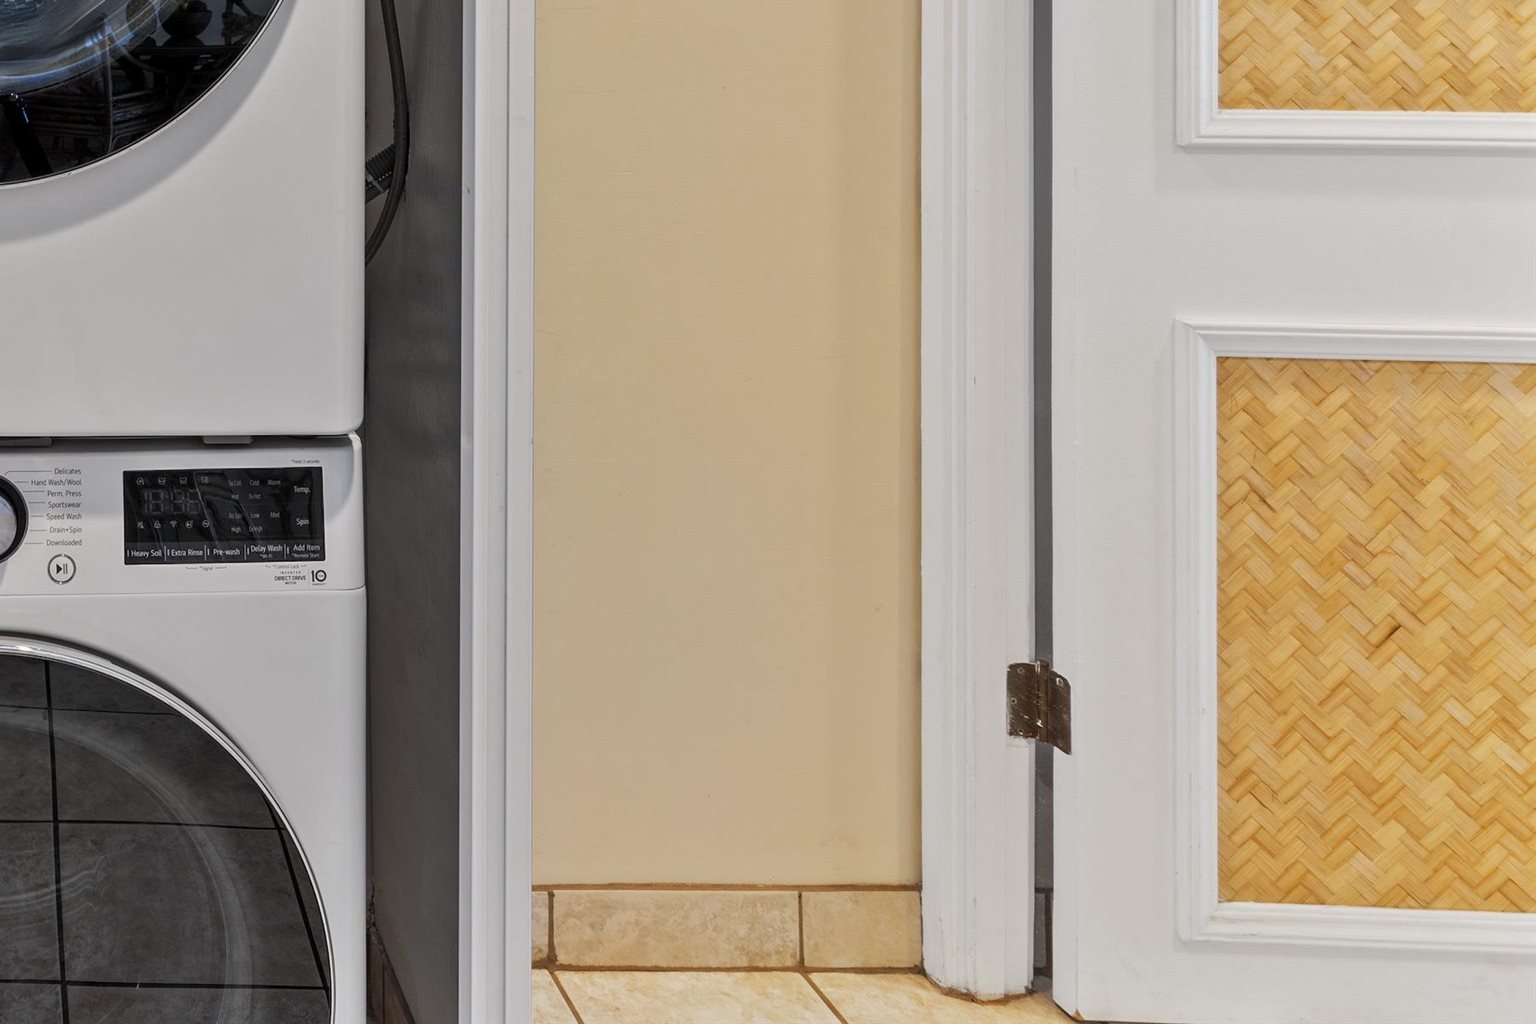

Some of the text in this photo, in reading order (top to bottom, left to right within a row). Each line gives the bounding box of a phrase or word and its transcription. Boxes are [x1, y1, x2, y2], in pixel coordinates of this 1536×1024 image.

[294, 486, 311, 494] Temp.
[48, 501, 82, 509] Sportswear
[296, 518, 310, 527] Spin
[213, 548, 240, 556] Pre-wash
[250, 544, 283, 554] Delay Wash
[293, 543, 320, 552] Add Item
[130, 548, 162, 558] Heavy Soil
[171, 548, 204, 557] Extra Rinse
[311, 570, 327, 582] 10
